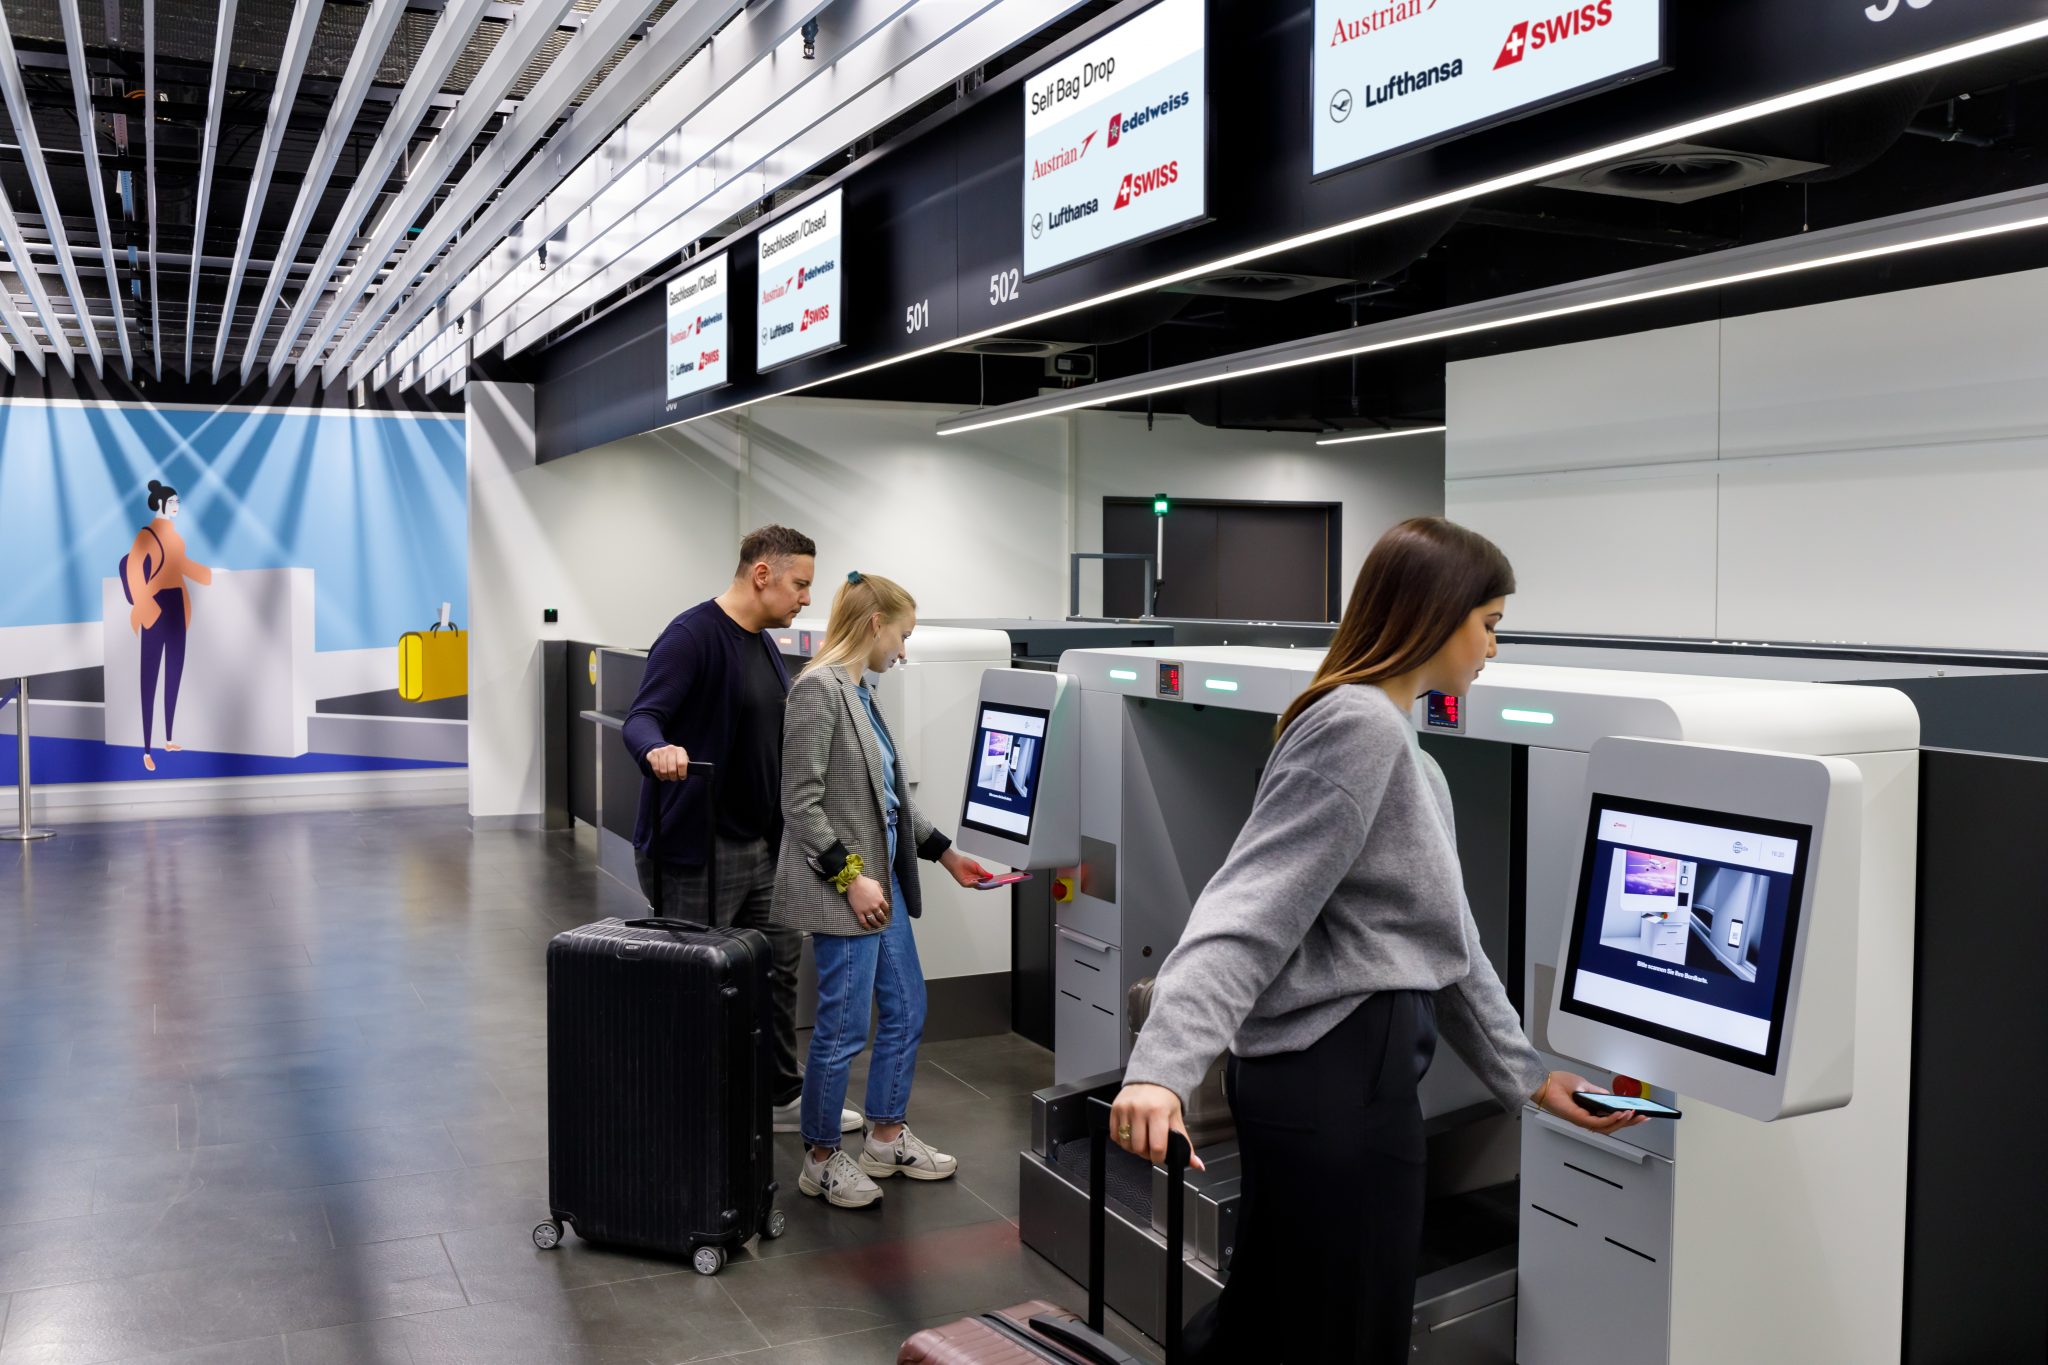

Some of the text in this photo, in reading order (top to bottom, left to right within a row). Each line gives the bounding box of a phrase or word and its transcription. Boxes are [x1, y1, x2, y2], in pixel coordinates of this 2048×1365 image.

[1330, 0, 1421, 47] Austrian
[1531, 0, 1612, 50] SWISS
[1031, 56, 1115, 116] Self Bag Drop
[1365, 57, 1464, 108] Lufthansa
[1121, 91, 1189, 134] edelweiss
[1031, 146, 1078, 181] Austrian
[1133, 160, 1178, 197] SWISS
[1048, 197, 1099, 230] Lufthansa
[803, 260, 834, 282] edelweiss
[990, 268, 1019, 306] 502
[769, 322, 794, 340] Lufthansa
[808, 304, 829, 326] SWISS
[906, 299, 929, 334] 501
